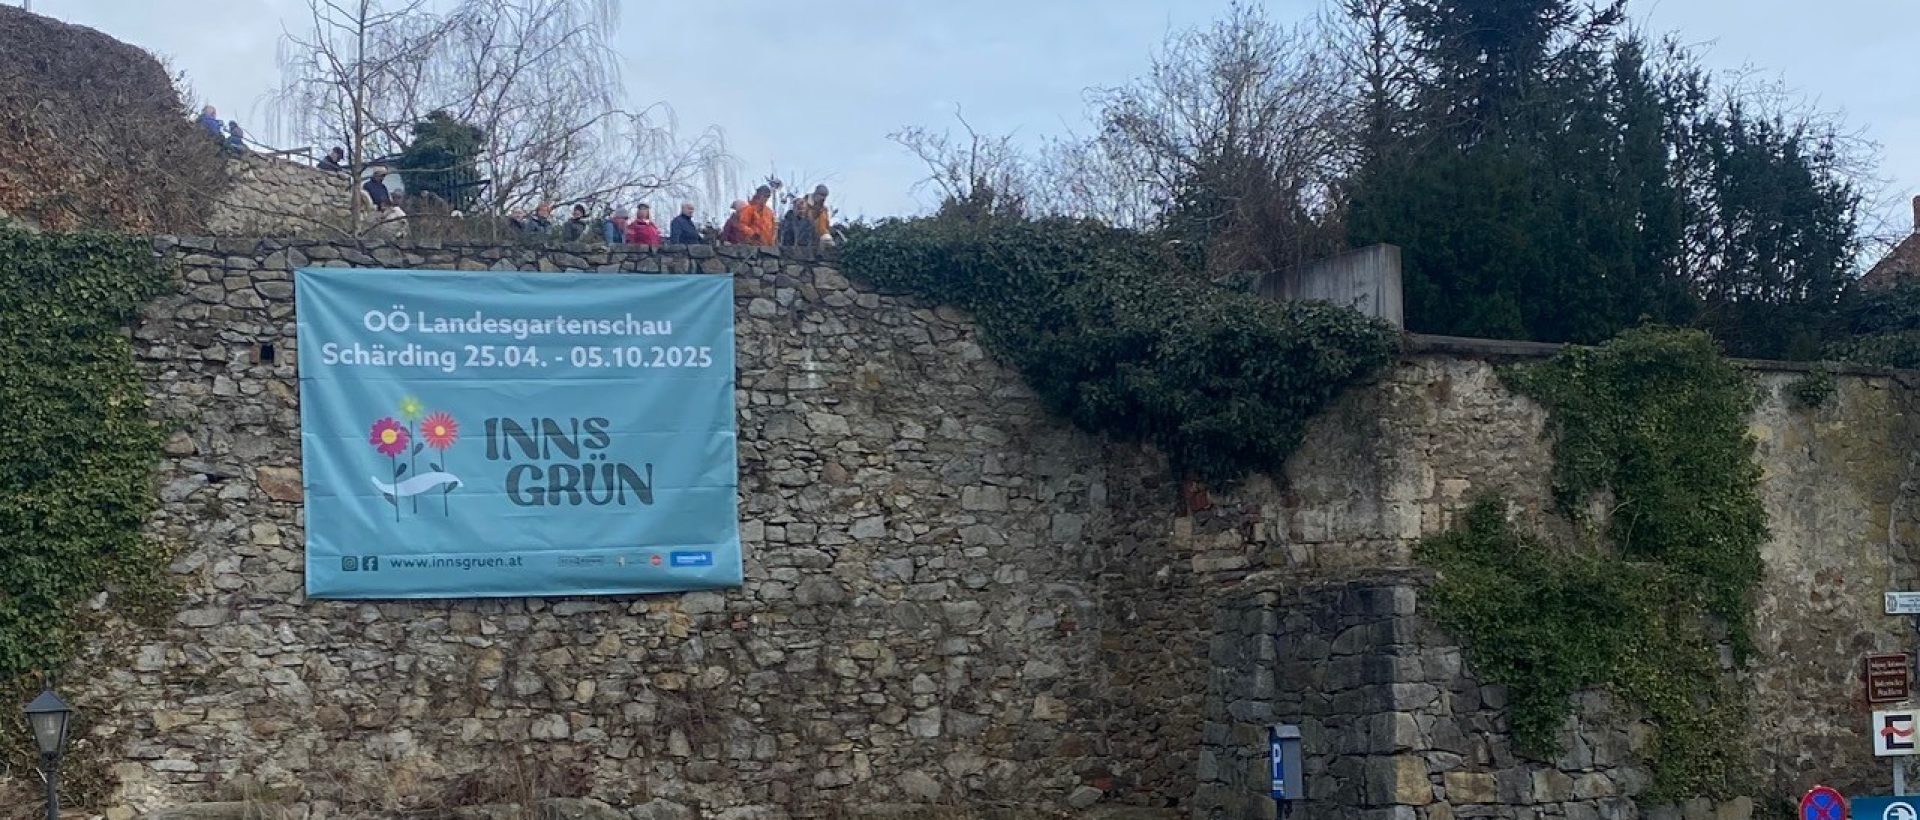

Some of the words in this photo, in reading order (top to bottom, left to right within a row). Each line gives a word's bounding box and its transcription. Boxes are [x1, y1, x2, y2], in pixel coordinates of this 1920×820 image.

[363, 306, 410, 333] OÖ
[417, 311, 672, 340] Landesgartenschau
[322, 342, 457, 373] Schärding
[463, 345, 548, 368] 25.04.
[570, 347, 713, 368] 05.10.2025
[484, 417, 611, 460] INNS
[506, 453, 654, 506] GRÜN
[390, 556, 523, 570] www.innsgruen.at
[1273, 743, 1281, 778] P
